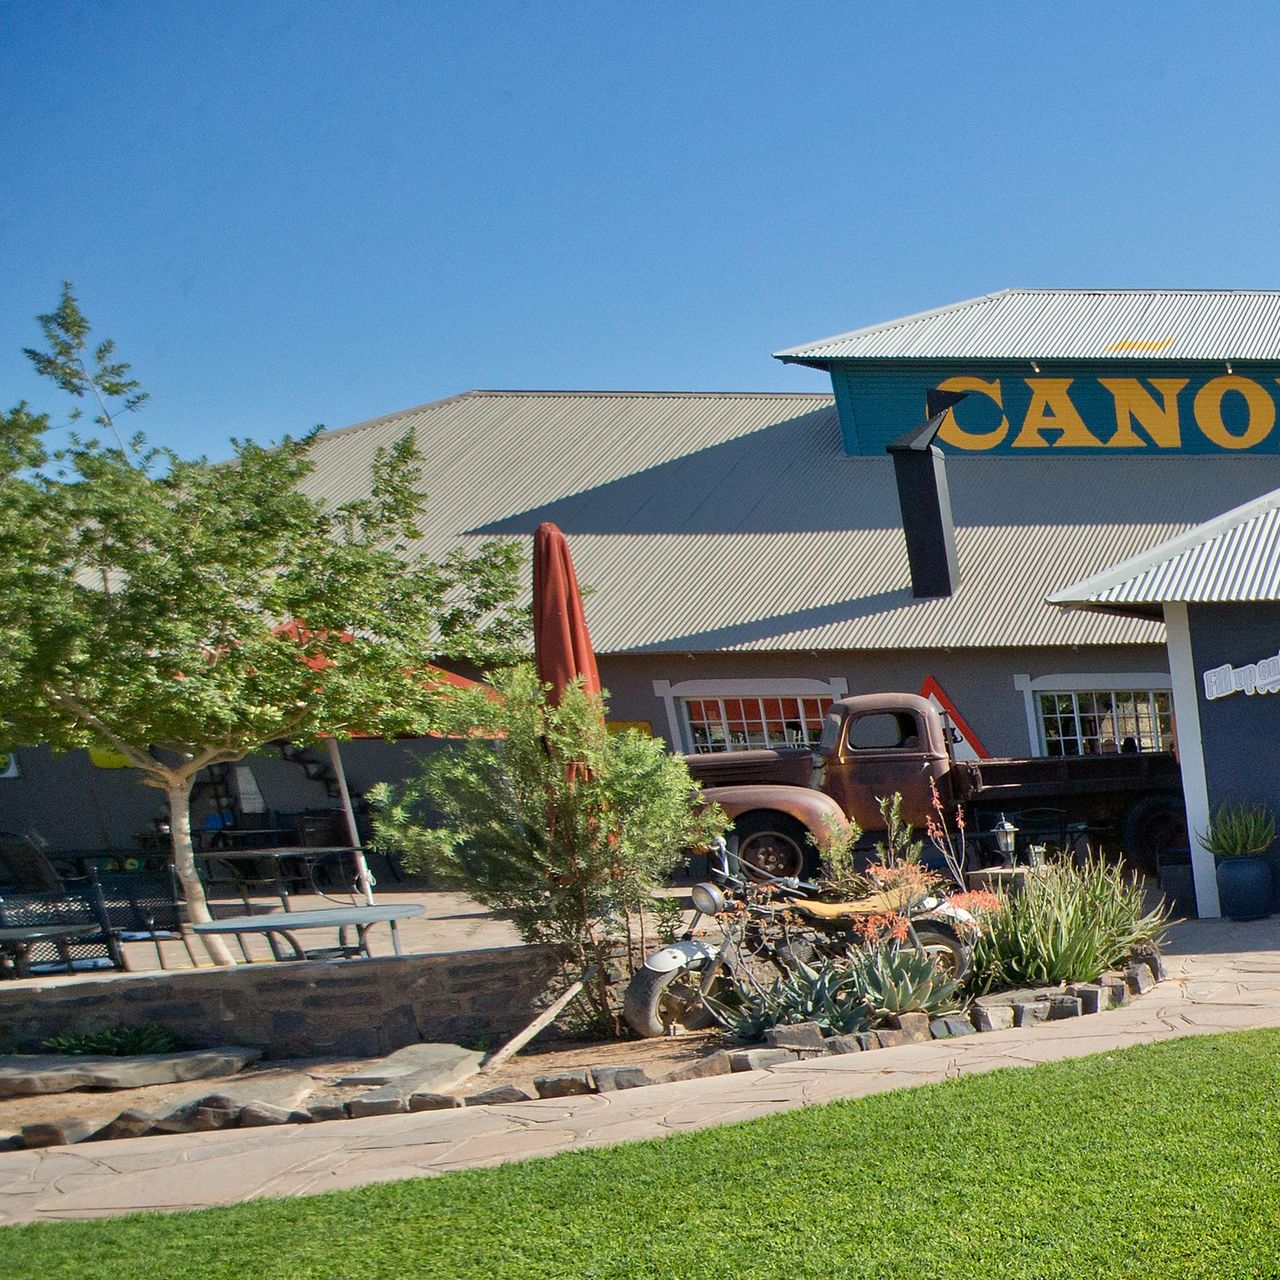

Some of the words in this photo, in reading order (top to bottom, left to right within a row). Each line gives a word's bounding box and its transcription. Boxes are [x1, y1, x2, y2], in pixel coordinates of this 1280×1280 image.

[1205, 664, 1233, 699] Fill
[1234, 664, 1257, 695] up
[1259, 659, 1280, 681] on
